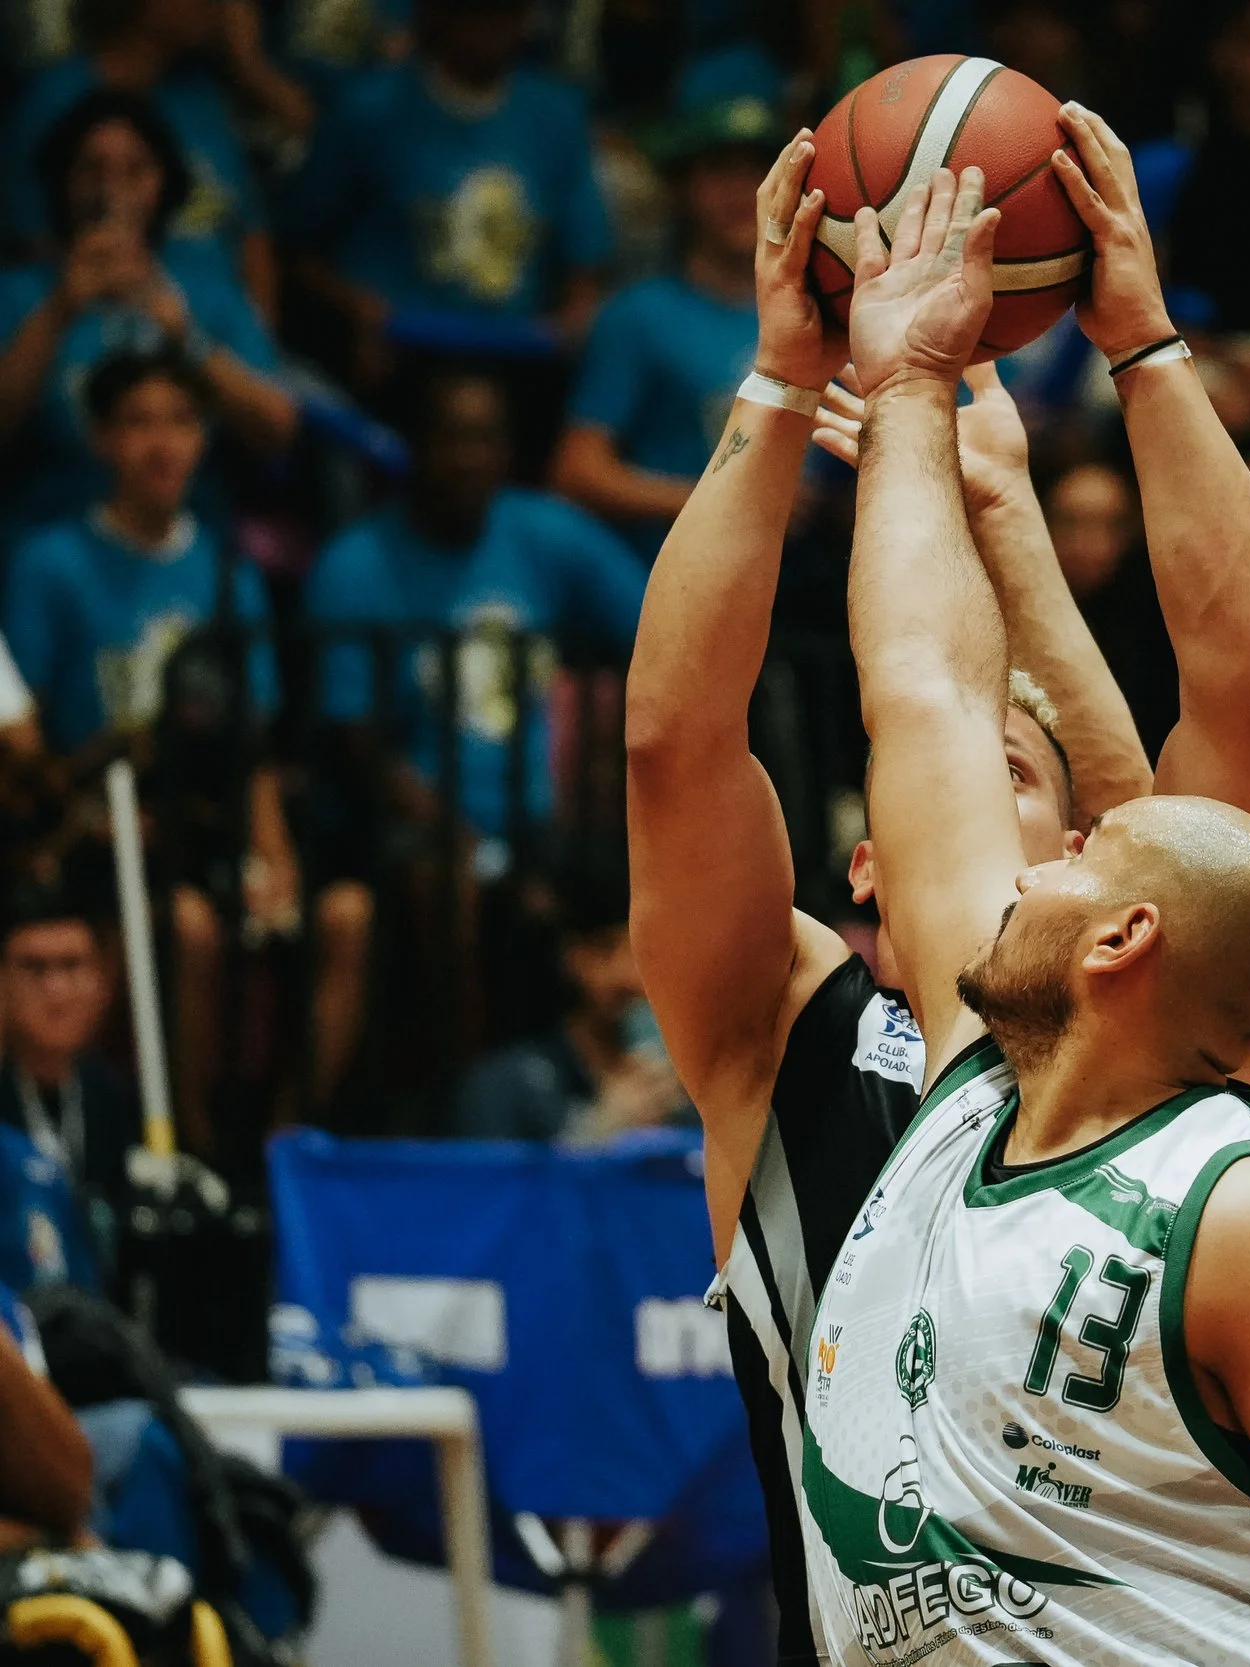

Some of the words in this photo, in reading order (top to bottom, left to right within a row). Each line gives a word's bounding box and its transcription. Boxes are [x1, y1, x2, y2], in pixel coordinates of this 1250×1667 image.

[878, 1042, 909, 1058] CLUB
[1023, 1244, 1151, 1413] 13
[1031, 1434, 1101, 1461] Coloplast
[855, 1559, 1050, 1651] ADFEGO
